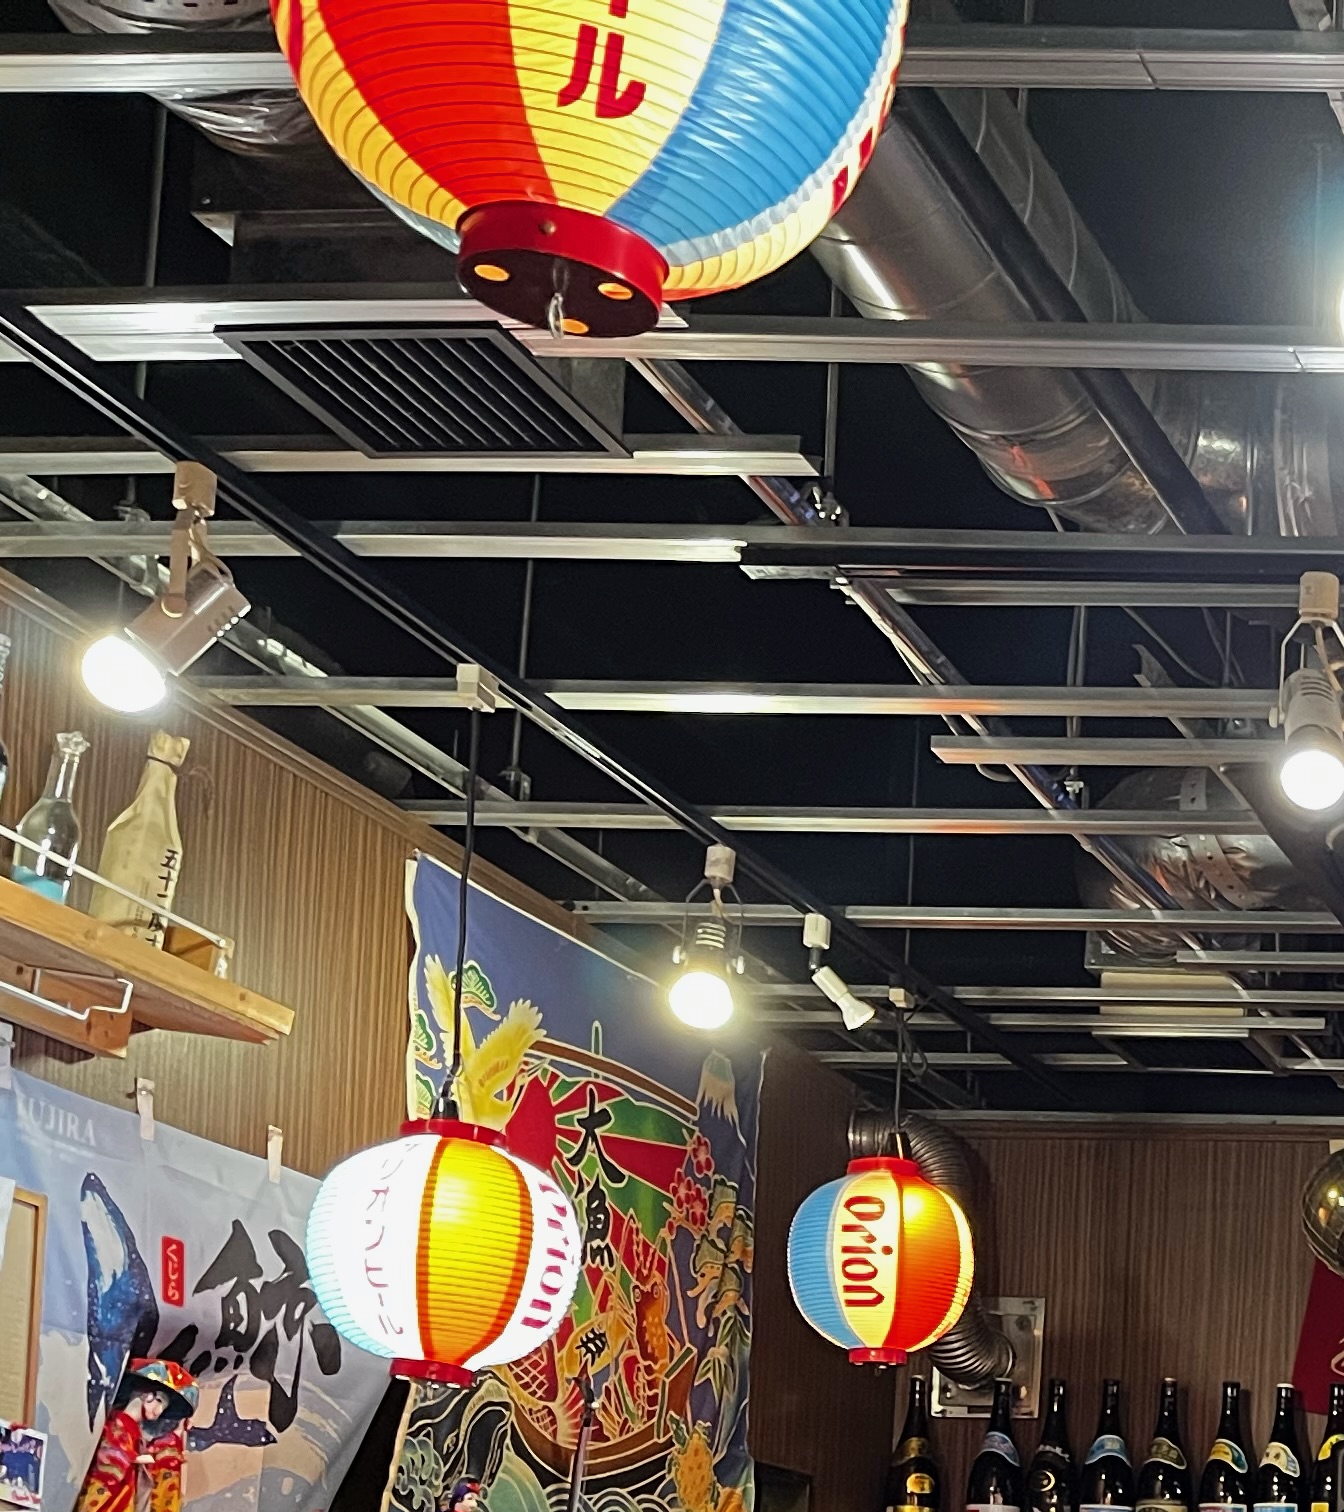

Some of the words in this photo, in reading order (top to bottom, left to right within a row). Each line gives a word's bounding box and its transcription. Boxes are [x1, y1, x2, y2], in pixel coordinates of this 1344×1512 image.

[557, 0, 646, 118] ル
[165, 1241, 181, 1302] くじら
[842, 1195, 894, 1308] Orion
